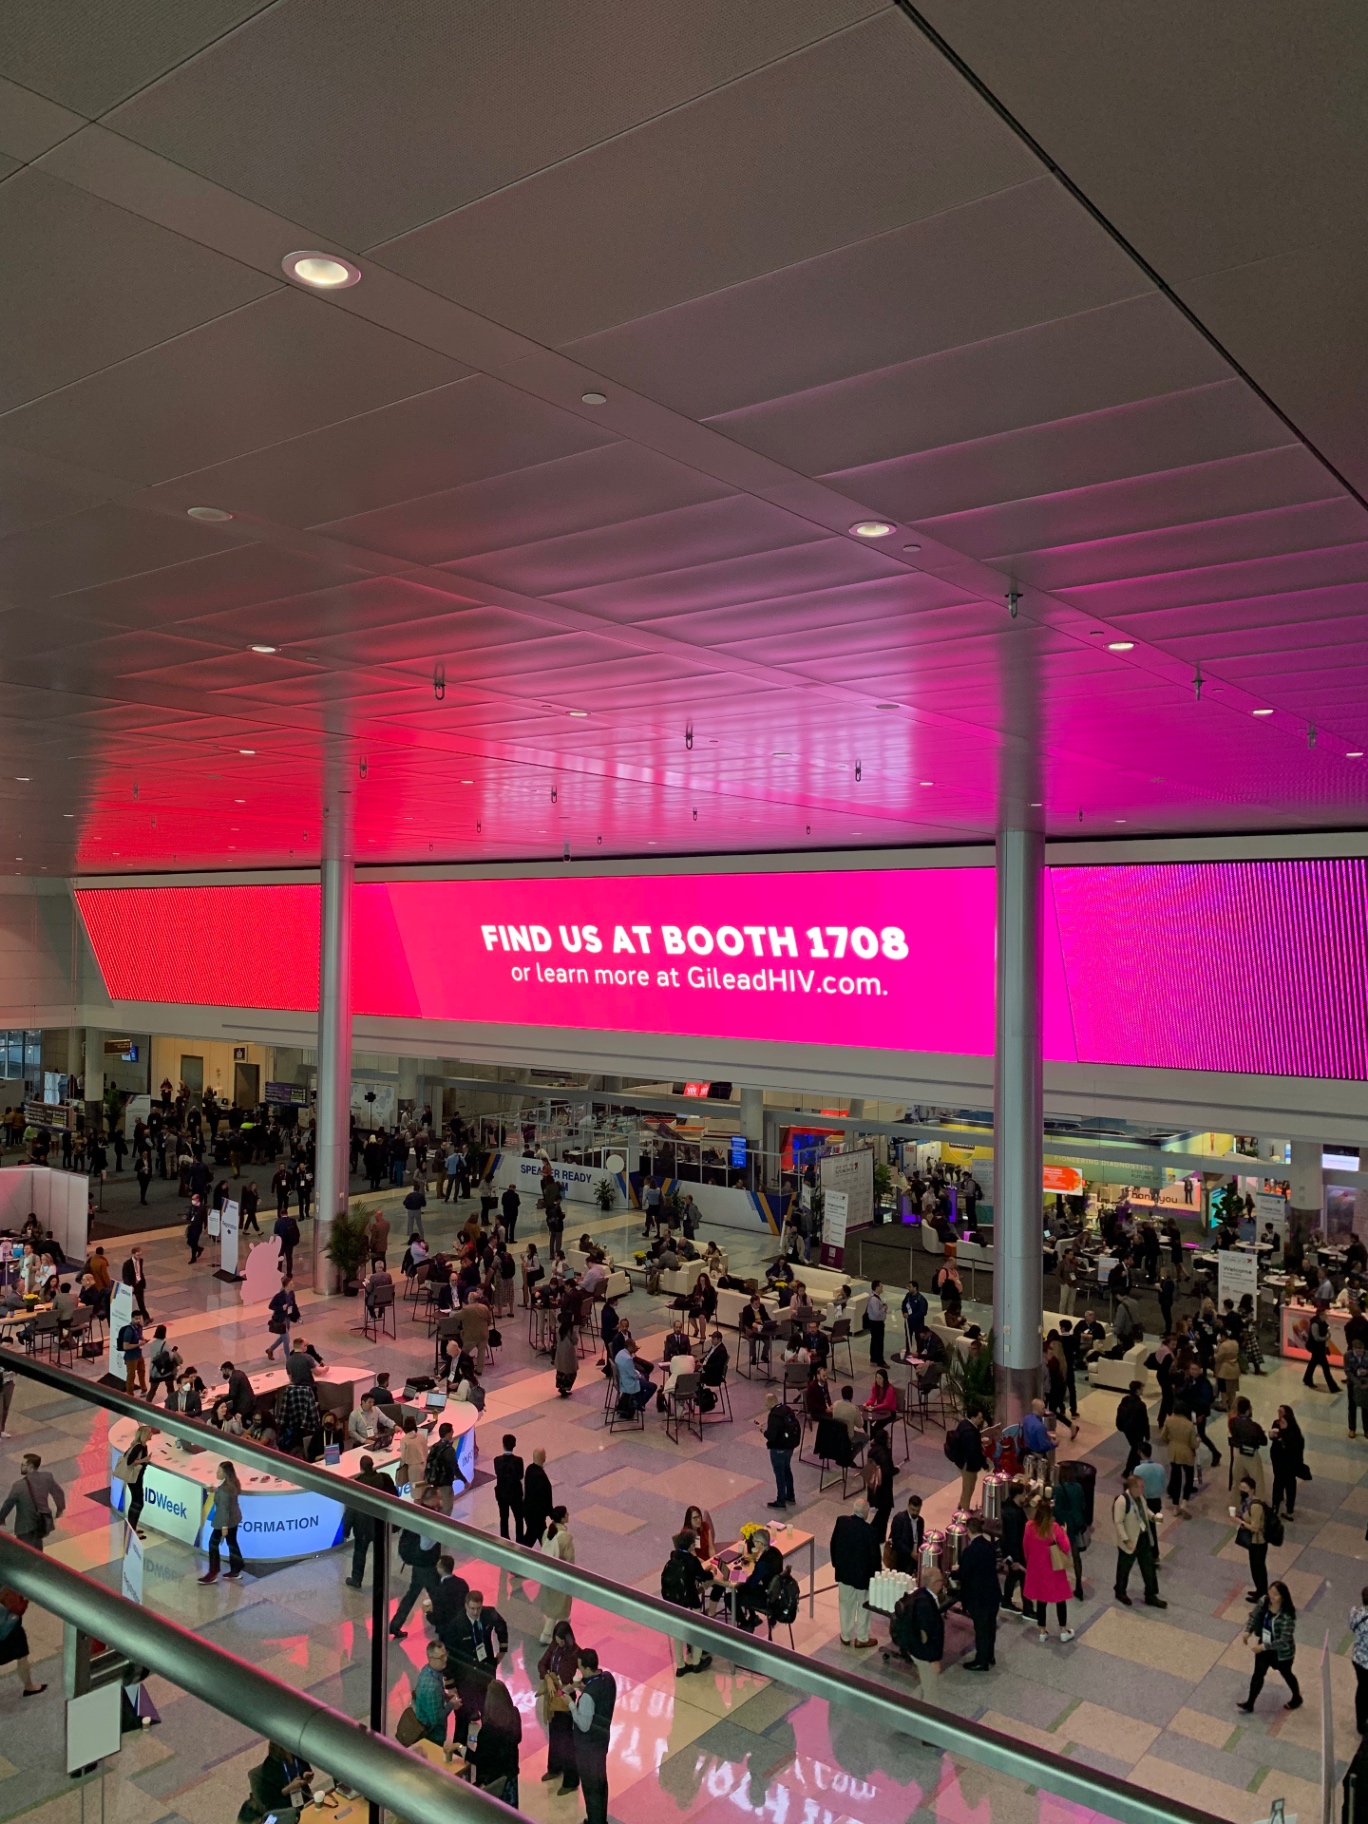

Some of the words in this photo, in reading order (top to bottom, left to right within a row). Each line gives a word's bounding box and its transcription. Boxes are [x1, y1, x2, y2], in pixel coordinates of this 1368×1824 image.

[480, 924, 553, 953] FIND
[557, 924, 604, 955] US
[612, 925, 653, 955] AT
[660, 925, 799, 959] BOOTH
[805, 926, 909, 962] 1708
[511, 966, 531, 983] or
[535, 962, 590, 985] learn
[594, 968, 650, 988] more
[656, 966, 681, 988] at
[687, 965, 888, 996] GileadHIV.com.
[1054, 1155, 1099, 1165] PIONEERING
[1101, 1160, 1154, 1171] DIAGNOSTICS
[562, 1170, 592, 1183] READY
[1159, 1195, 1178, 1204] you
[144, 1486, 187, 1519] IDWeek
